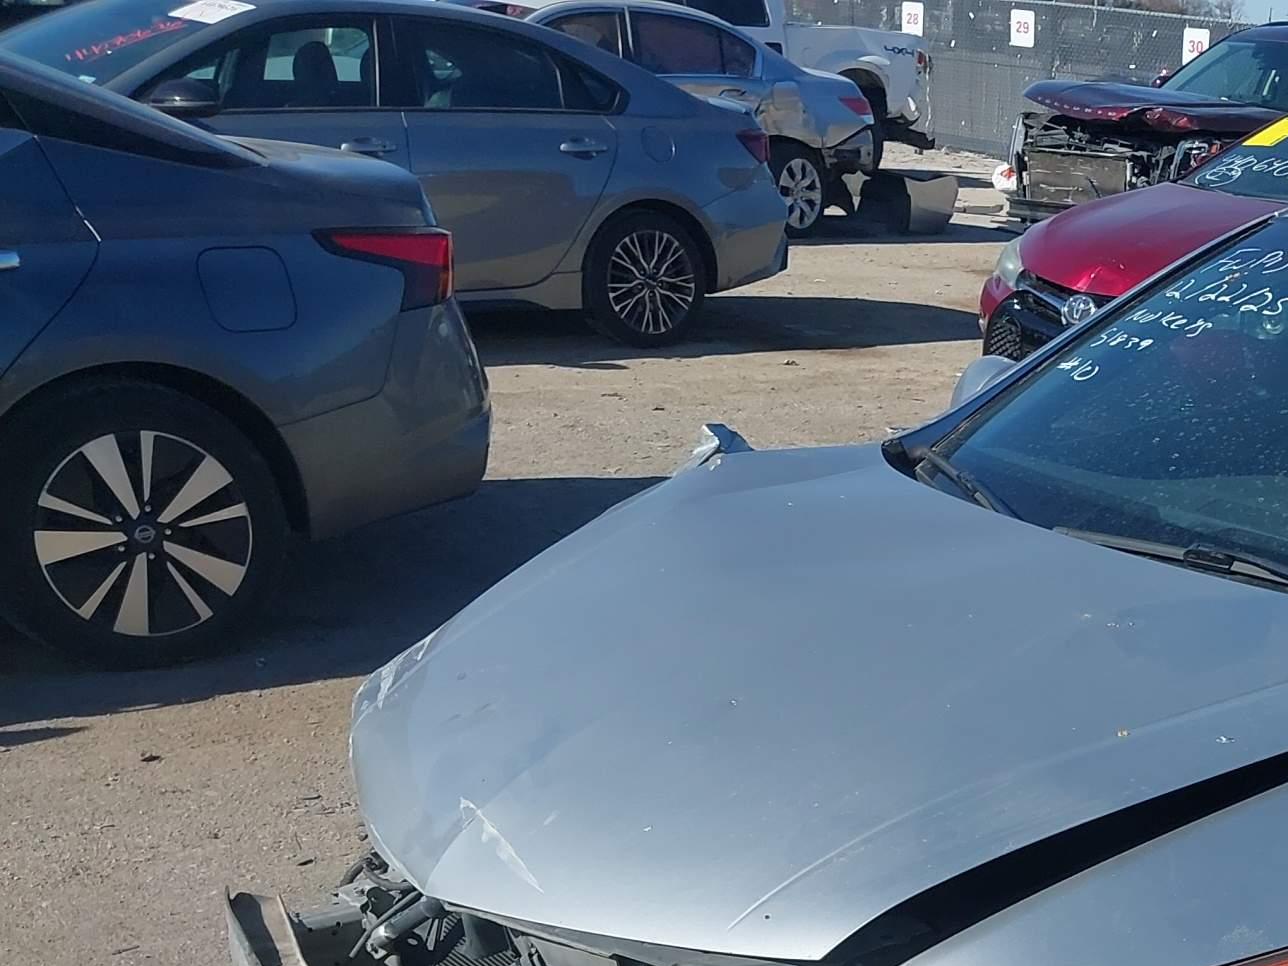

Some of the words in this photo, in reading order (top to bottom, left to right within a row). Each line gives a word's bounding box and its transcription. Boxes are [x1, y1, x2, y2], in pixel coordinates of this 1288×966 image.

[906, 12, 919, 25] 28
[1016, 21, 1029, 34] 29
[1188, 40, 1204, 54] 30
